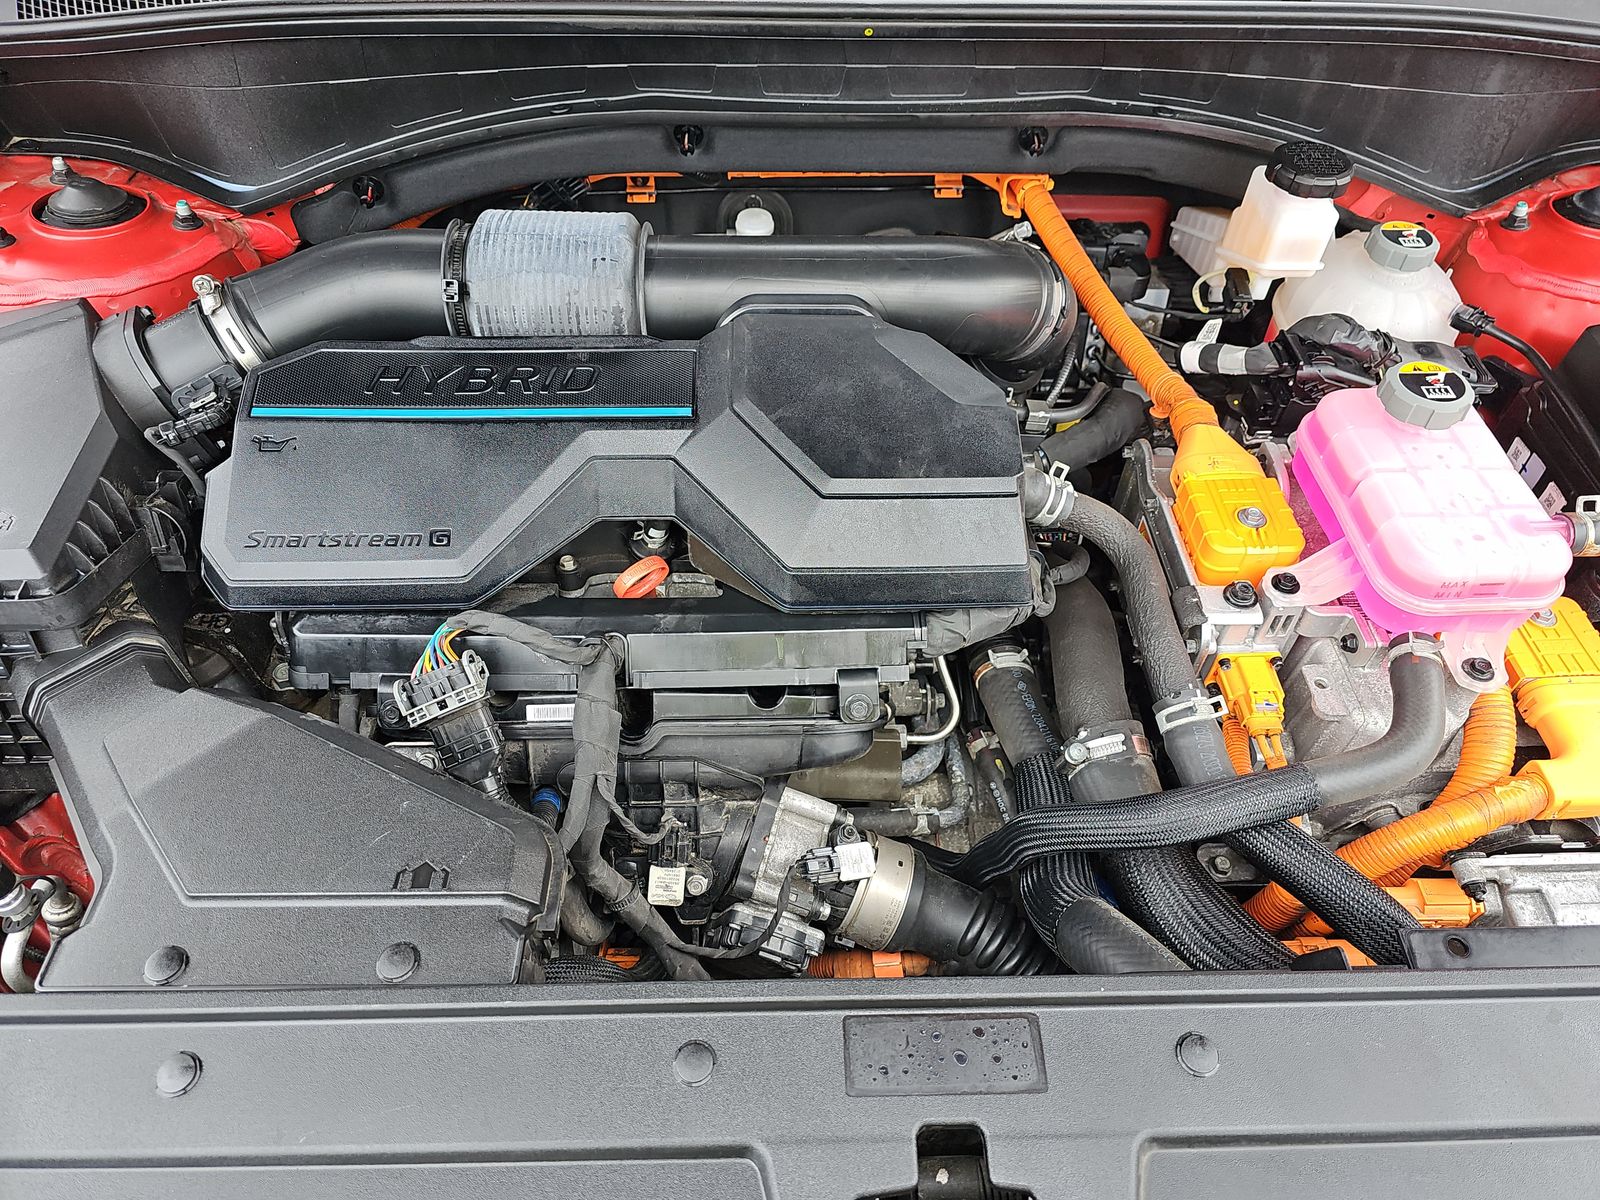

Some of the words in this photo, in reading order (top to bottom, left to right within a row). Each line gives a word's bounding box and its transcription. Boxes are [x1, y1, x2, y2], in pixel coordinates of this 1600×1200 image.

[364, 365, 600, 395] HYBRID
[244, 529, 423, 548] Smartstream
[428, 527, 452, 547] G
[1440, 581, 1469, 589] MAX
[1434, 591, 1463, 599] MIN
